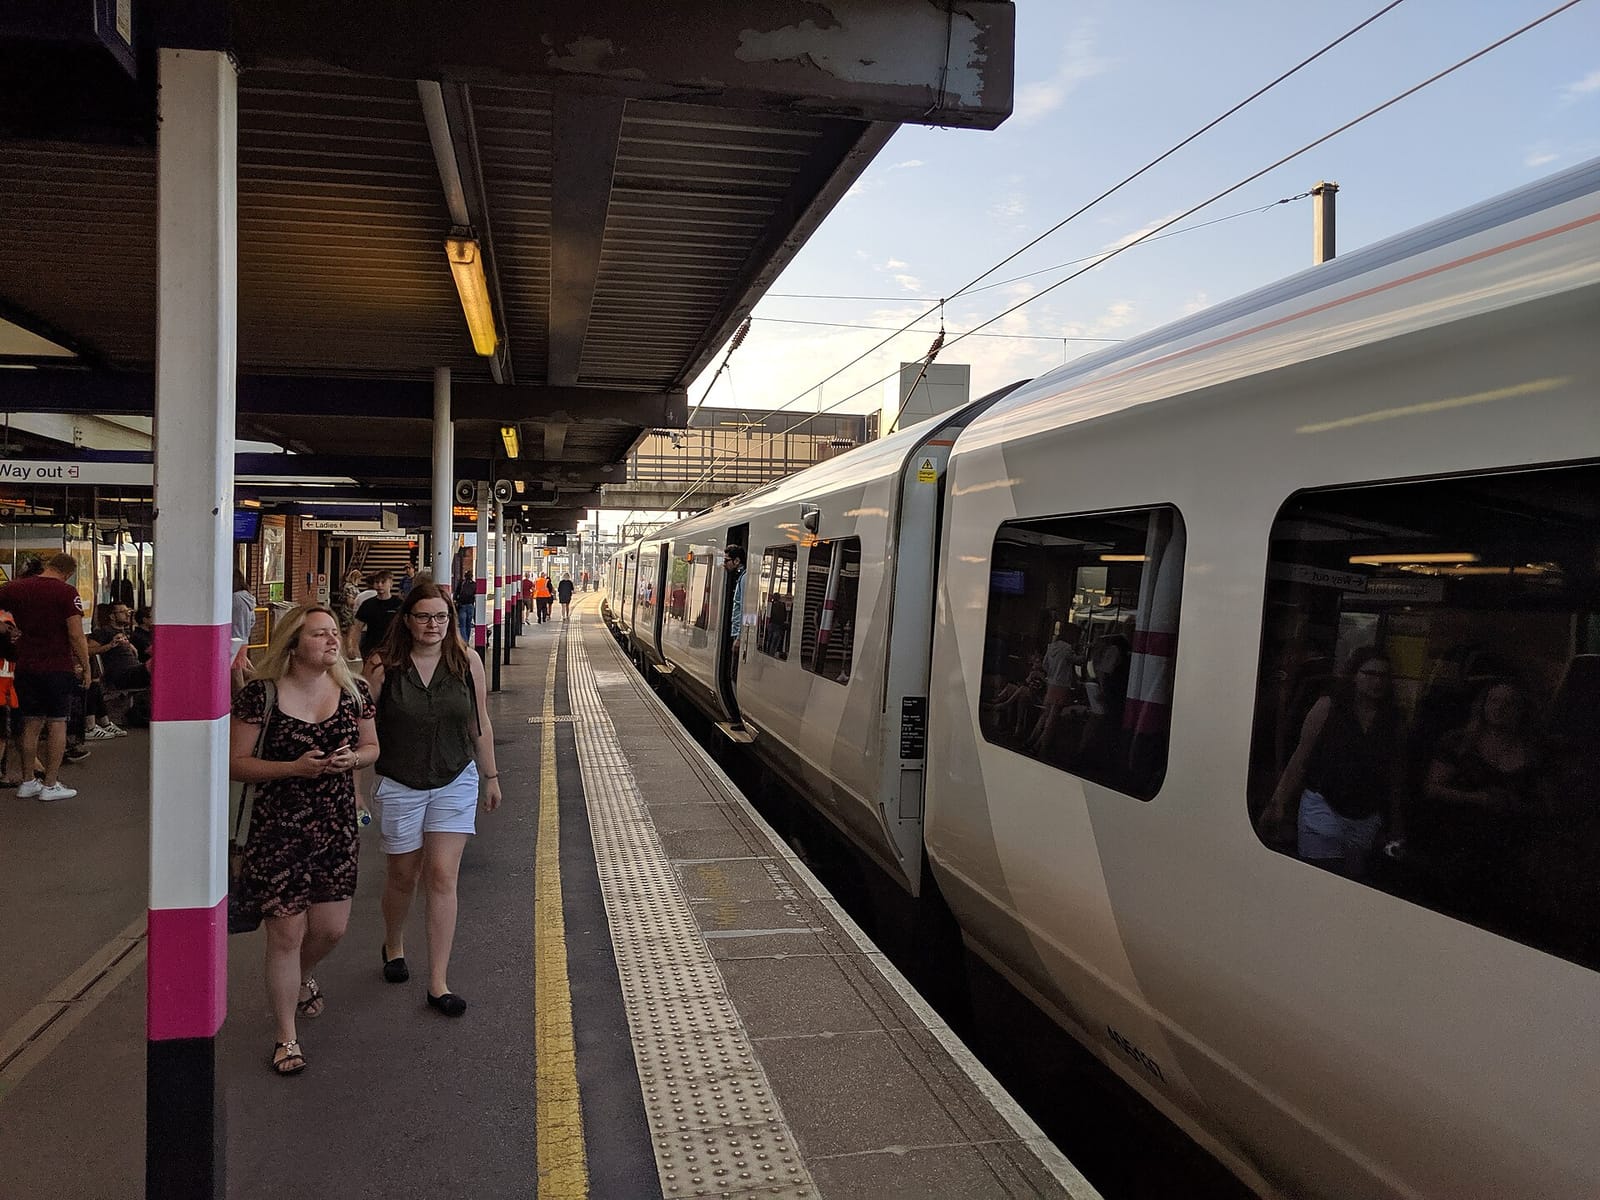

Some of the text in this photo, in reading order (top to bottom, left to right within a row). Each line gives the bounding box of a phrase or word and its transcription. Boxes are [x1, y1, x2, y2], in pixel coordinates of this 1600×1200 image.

[0, 464, 63, 480] Way out
[315, 520, 338, 529] Ladies
